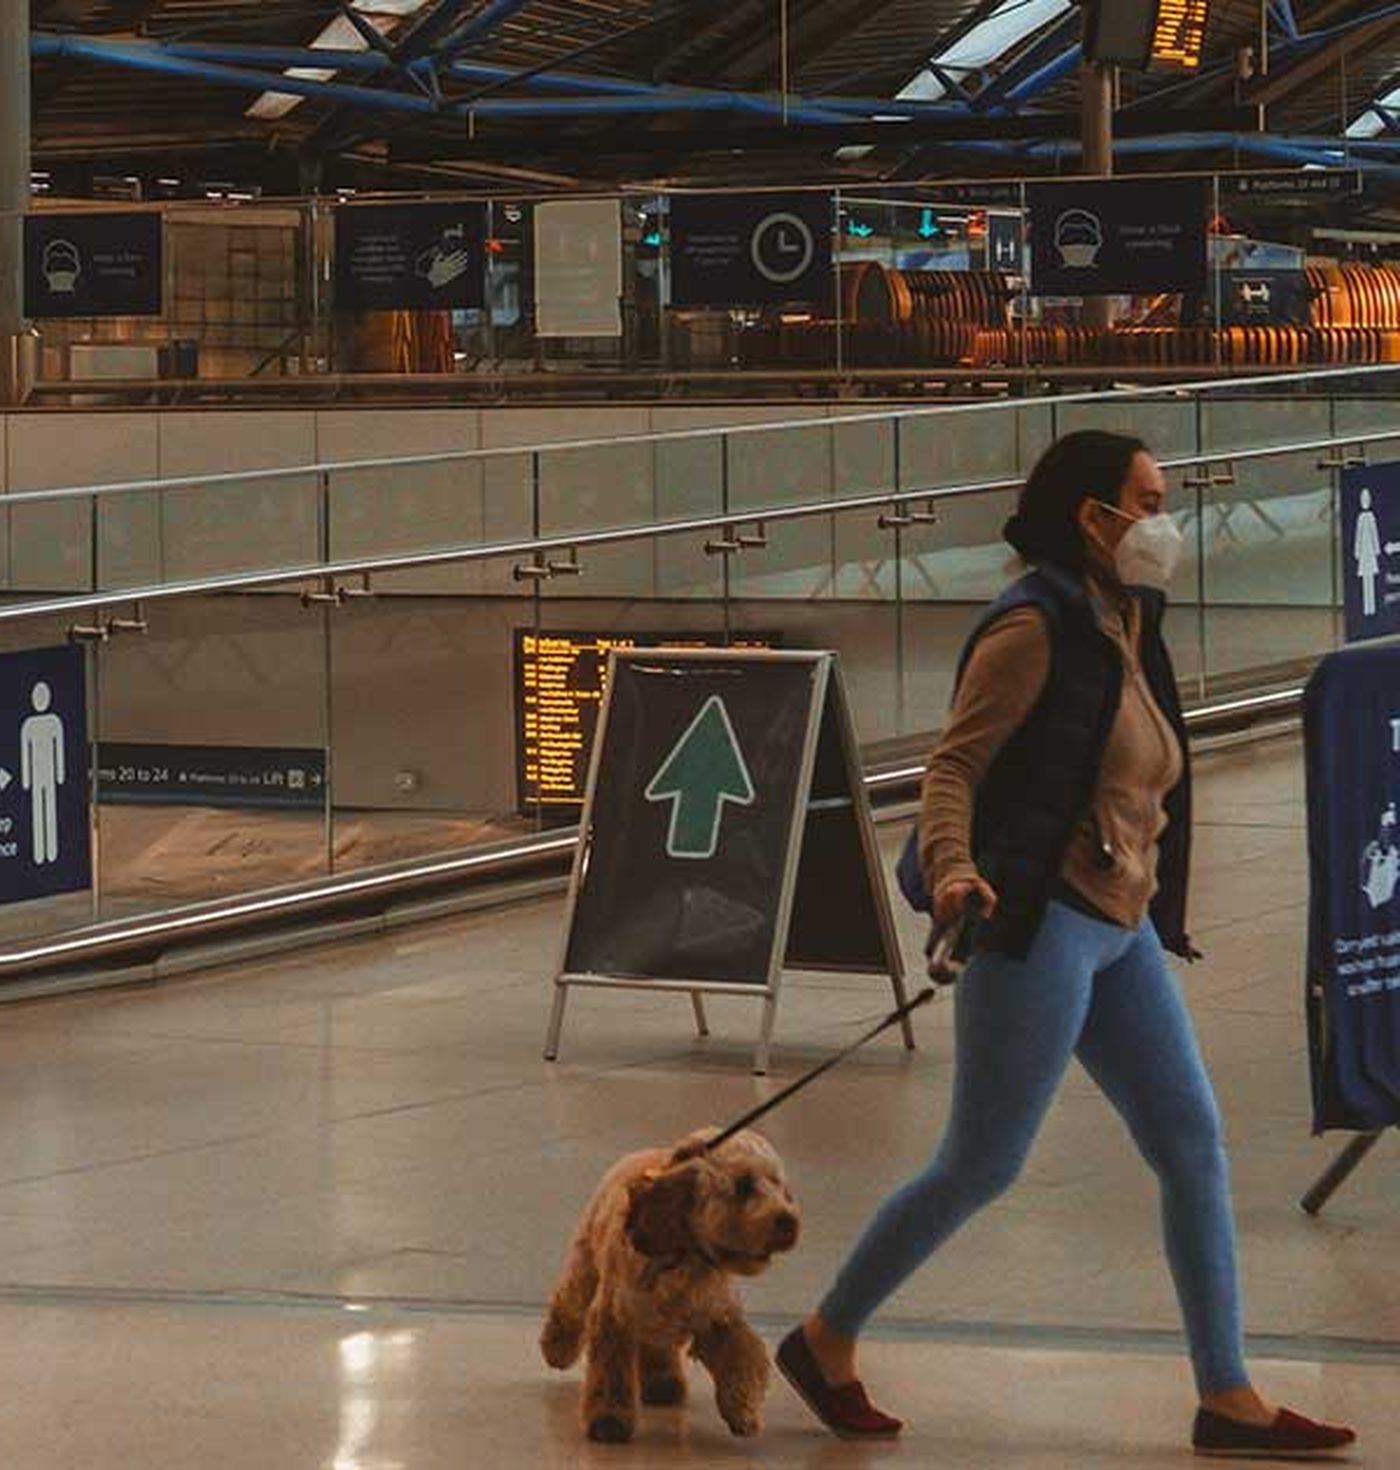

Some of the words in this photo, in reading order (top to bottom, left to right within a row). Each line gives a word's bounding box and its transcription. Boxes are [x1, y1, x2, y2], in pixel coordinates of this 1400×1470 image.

[118, 765, 135, 782] 20
[137, 768, 150, 782] to
[152, 766, 169, 782] 24
